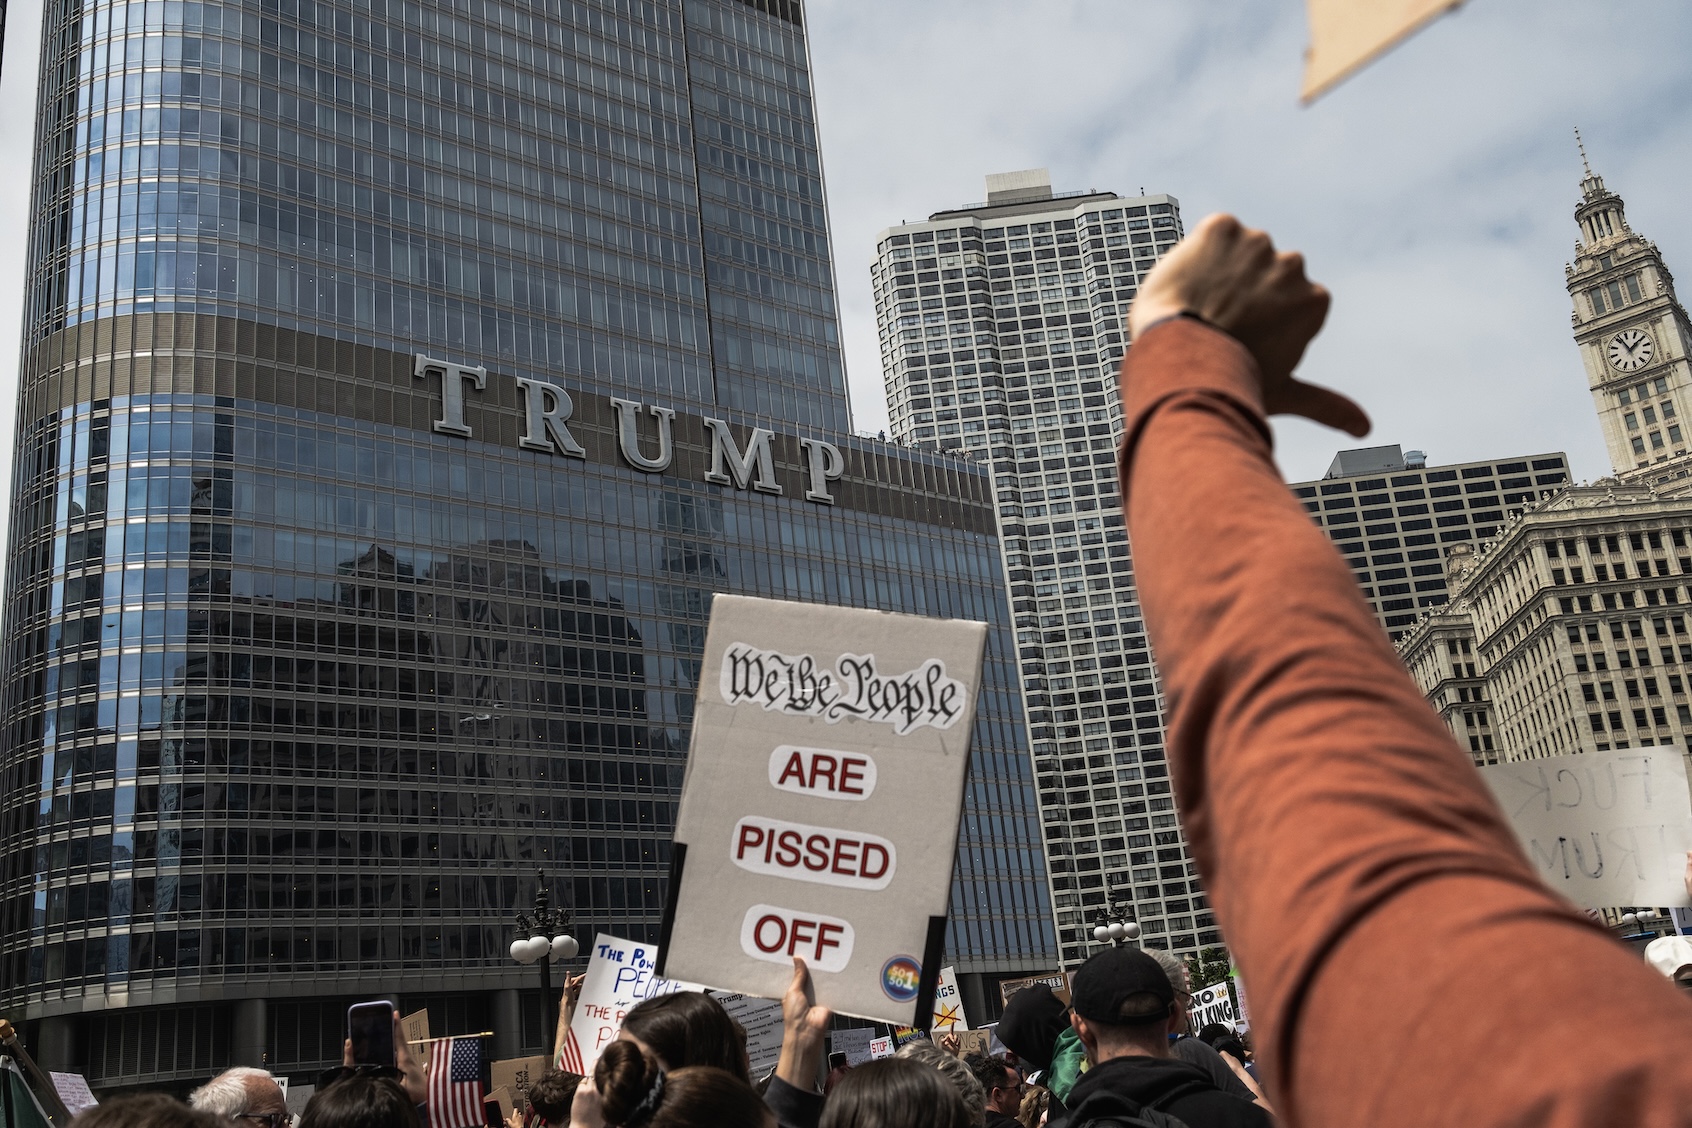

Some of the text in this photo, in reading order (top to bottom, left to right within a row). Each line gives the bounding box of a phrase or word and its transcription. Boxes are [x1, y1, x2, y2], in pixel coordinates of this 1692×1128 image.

[414, 353, 845, 505] TRUMP
[728, 648, 961, 733] We the People
[777, 751, 867, 795] ARE
[736, 824, 890, 880] PISSED
[753, 914, 844, 962] OFF
[598, 945, 655, 969] THE POW
[718, 993, 743, 1005] Trump
[935, 985, 955, 999] NGS
[585, 1004, 612, 1020] THE
[871, 1041, 888, 1054] STOP
[515, 1070, 523, 1090] CCA
